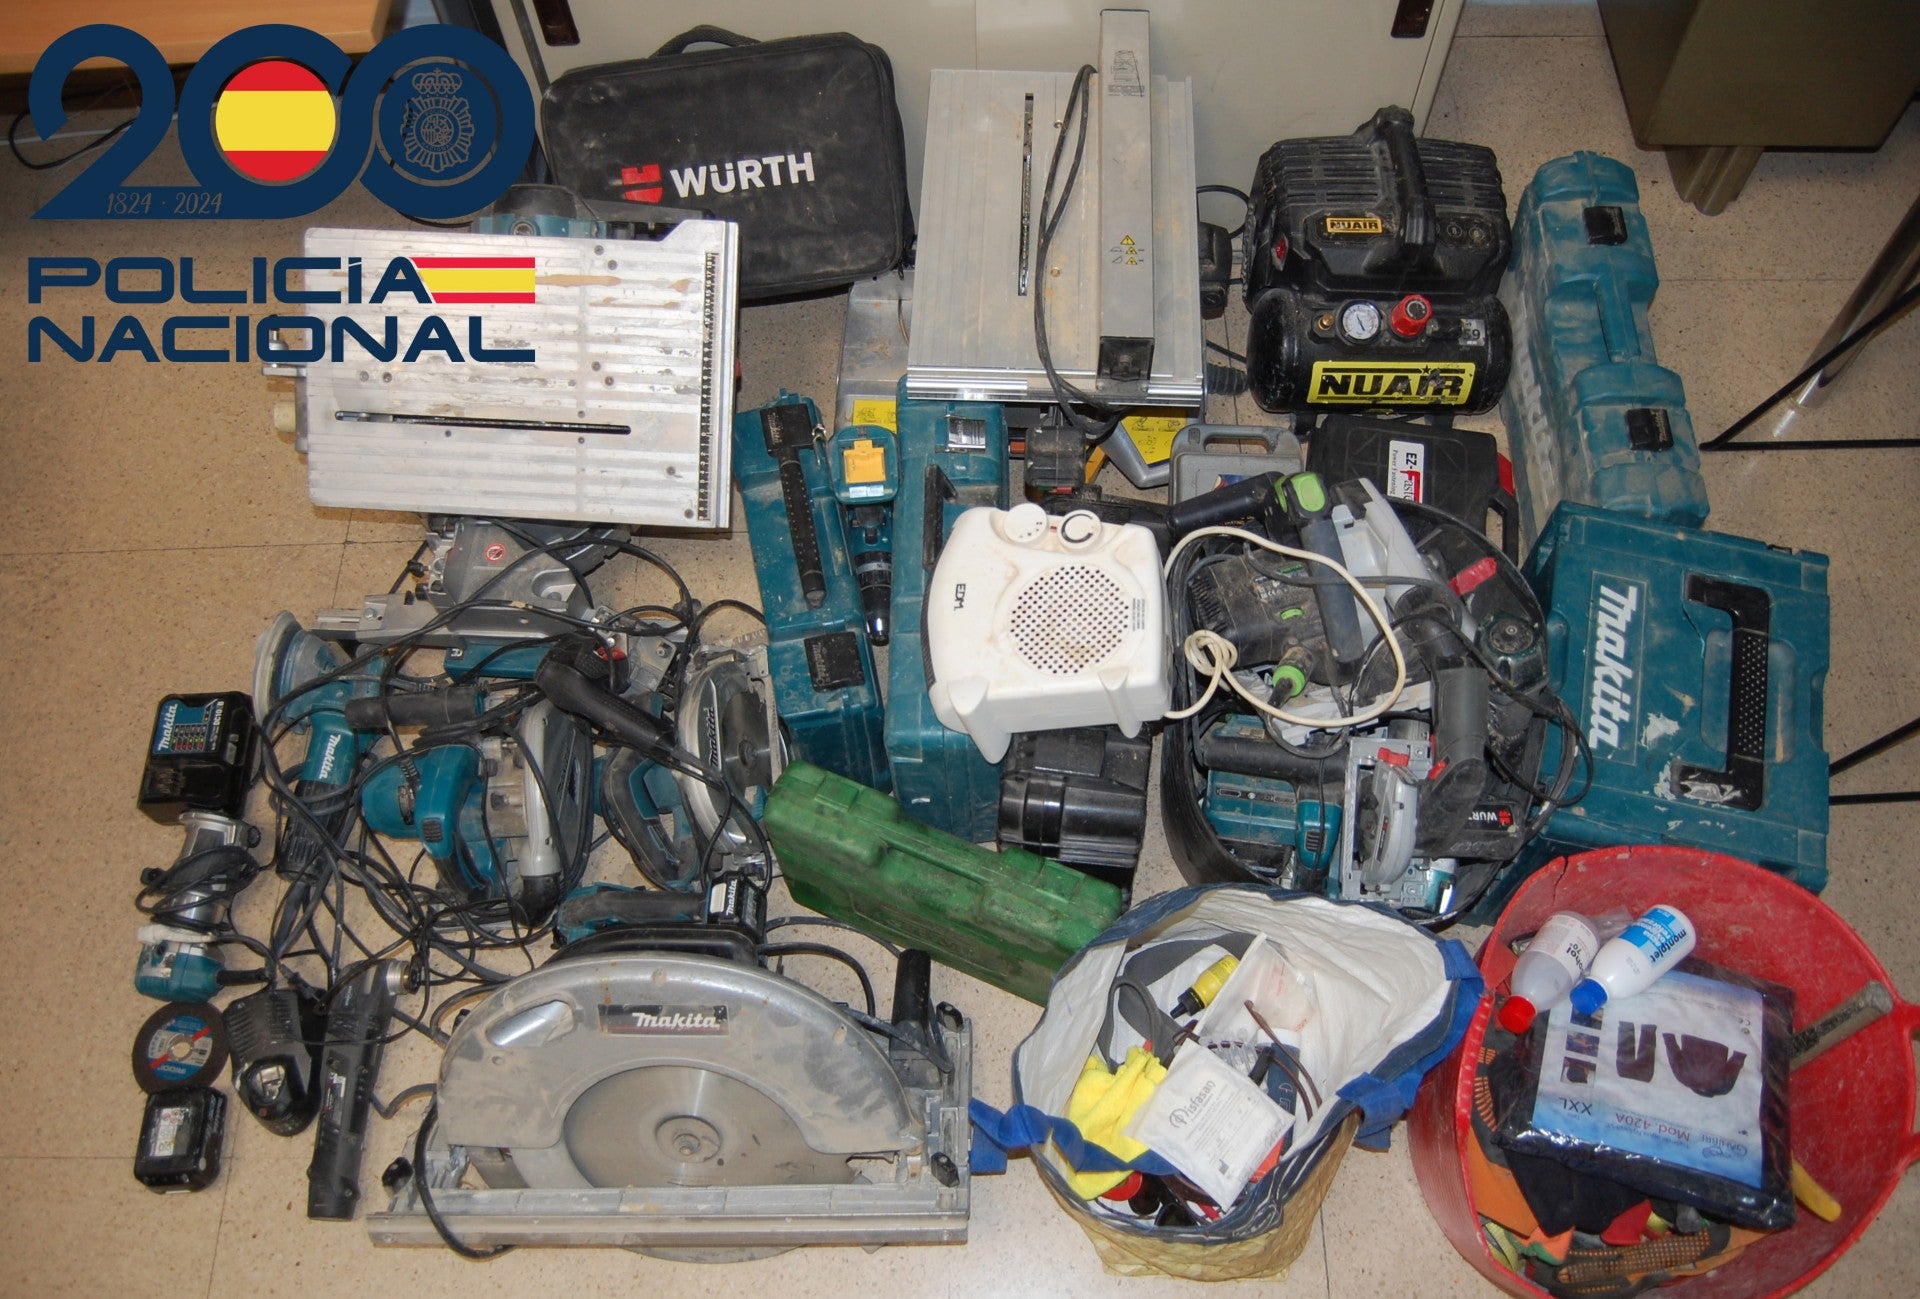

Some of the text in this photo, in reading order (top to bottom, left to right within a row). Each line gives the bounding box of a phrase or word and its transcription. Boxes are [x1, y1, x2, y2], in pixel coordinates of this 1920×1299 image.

[670, 152, 815, 199] WÜRTH
[1330, 220, 1379, 230] NUAIR
[1318, 374, 1465, 396] NUAIR
[954, 583, 966, 610] EDM
[1588, 585, 1638, 750] Makita
[158, 703, 178, 750] Makita
[320, 734, 341, 779] Makita
[1650, 929, 1687, 964] montplet
[632, 1012, 721, 1029] Makita
[1558, 1097, 1593, 1116] XXL
[1615, 1112, 1651, 1131] 420A
[1652, 1124, 1690, 1142] Mod.
